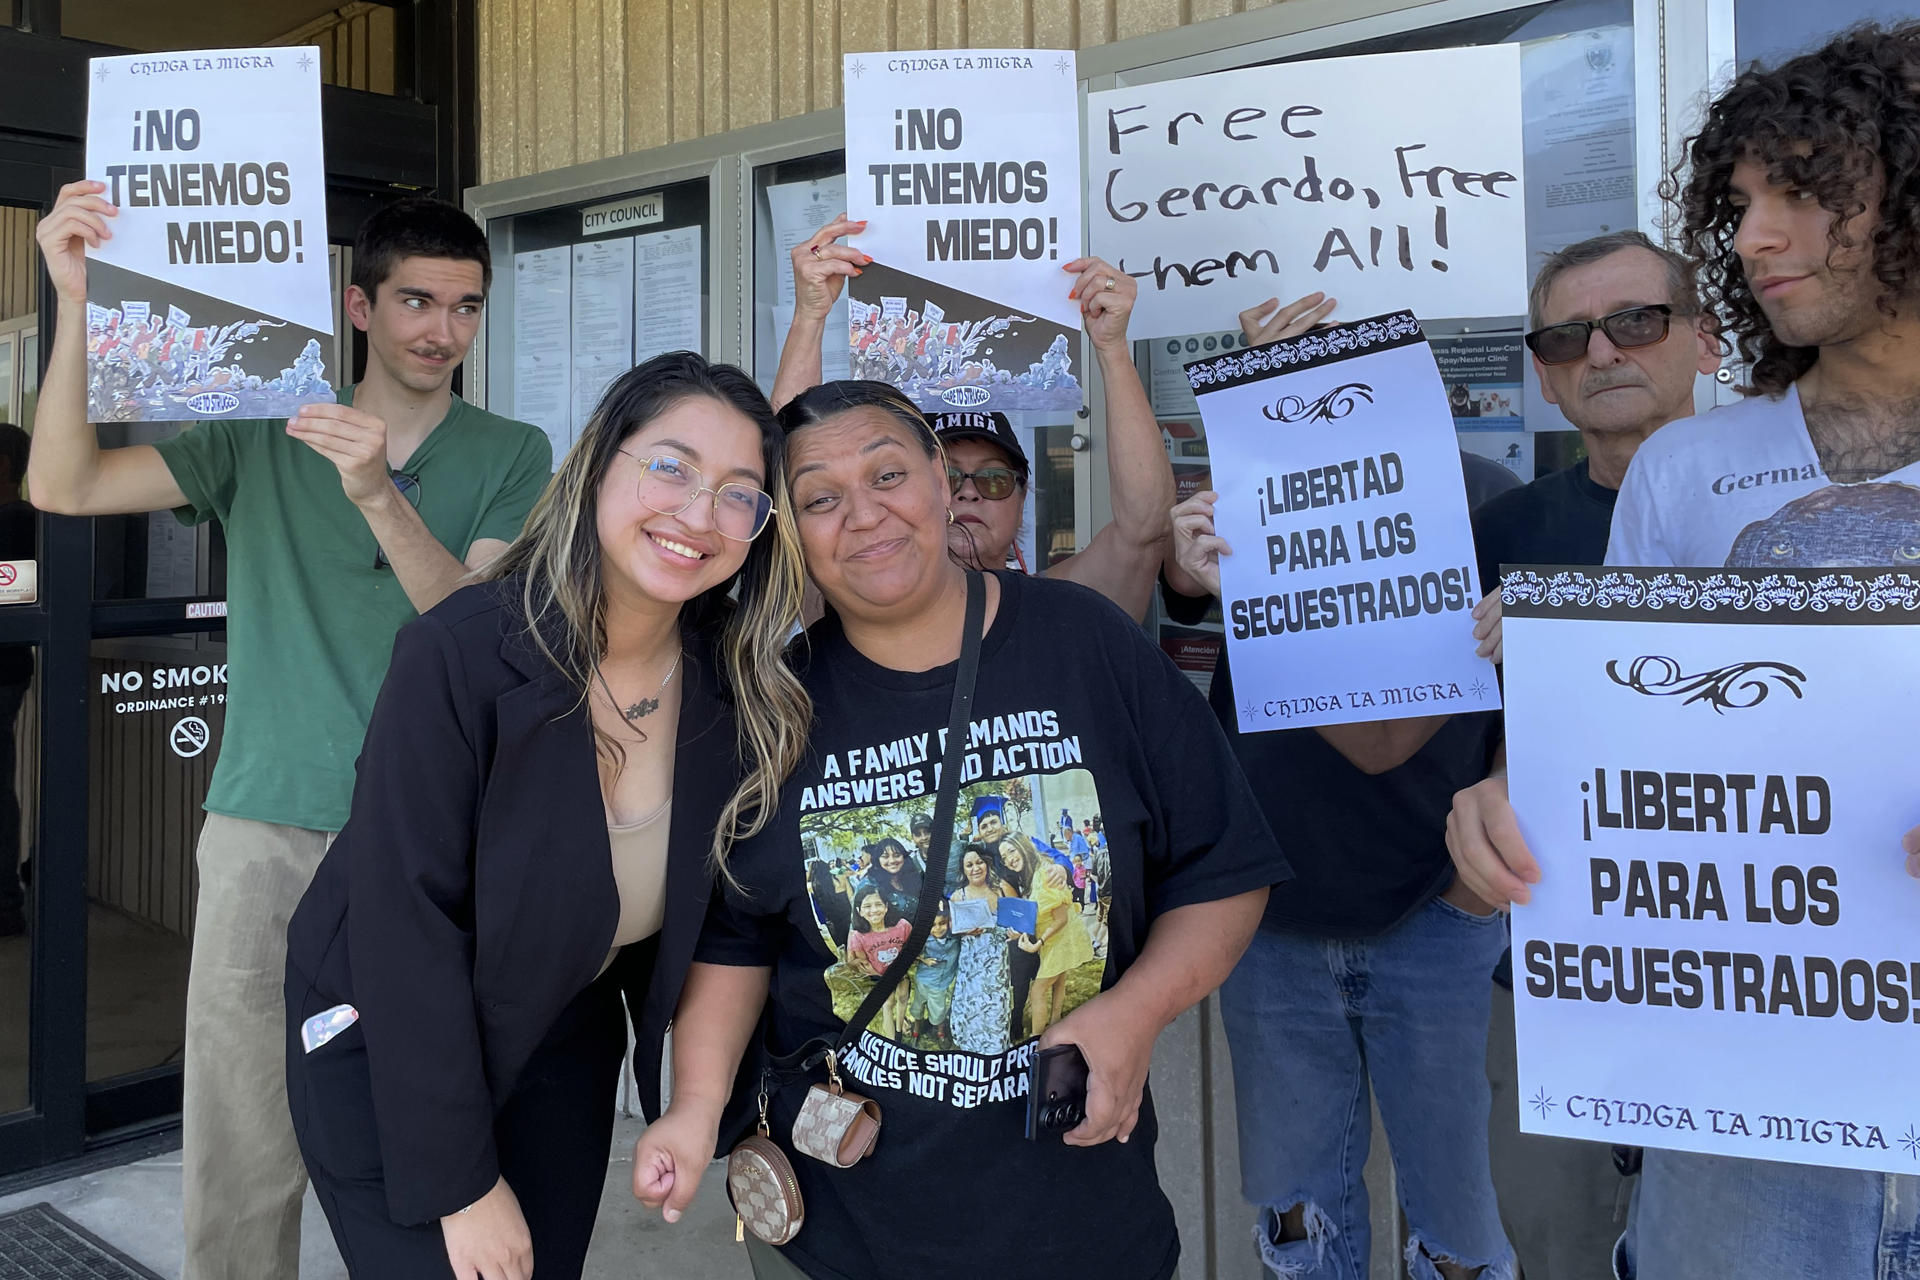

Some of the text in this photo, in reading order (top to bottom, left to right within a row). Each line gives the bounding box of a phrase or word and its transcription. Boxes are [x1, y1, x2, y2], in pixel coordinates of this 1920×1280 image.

[130, 56, 274, 75] CHINGA LA MIGRA
[888, 57, 1033, 73] CHINGA LA MIGRA
[133, 108, 200, 151] ¡NO
[895, 108, 963, 151] ¡NO
[1108, 104, 1323, 155] Free
[106, 162, 291, 208] TENEMOS
[868, 160, 1048, 206] TENEMOS
[1105, 155, 1380, 223] Gerardo,
[1394, 143, 1518, 199] Free
[584, 203, 658, 228] CITY COUNCIL
[166, 220, 303, 265] MIEDO!
[926, 217, 1058, 262] MIEDO!
[1119, 205, 1449, 291] them All!
[1438, 354, 1509, 365] Spay/Neuter Clinic
[1450, 345, 1485, 355] Regional
[1486, 344, 1521, 353] Low-Cost
[934, 412, 999, 435] AMIGA
[1257, 452, 1405, 527] ¡LIBERTAD
[1711, 463, 1818, 495] Germa
[1266, 512, 1417, 575] PARA LOS
[1230, 566, 1474, 640] SECUESTRADOS!
[101, 664, 228, 694] NO SMOK
[1263, 682, 1464, 719] CHINGA LA MIGRA
[115, 694, 228, 714] ORDINANCE #19
[800, 769, 925, 811] ANSWERS
[992, 735, 1083, 776] ACTION
[823, 754, 842, 779] A
[847, 732, 929, 776] FAMILY
[1580, 768, 1831, 842] ¡LIBERTAD
[1590, 858, 1840, 927] PARA LOS
[1524, 939, 1920, 1024] SECUESTRADOS!
[858, 1030, 1041, 1083] JUSTICE SHOULD PRO
[908, 1071, 948, 1101] NOT
[951, 1072, 1030, 1109] SEPARA
[1565, 1094, 1890, 1152] CHINGA LA MIGRA
